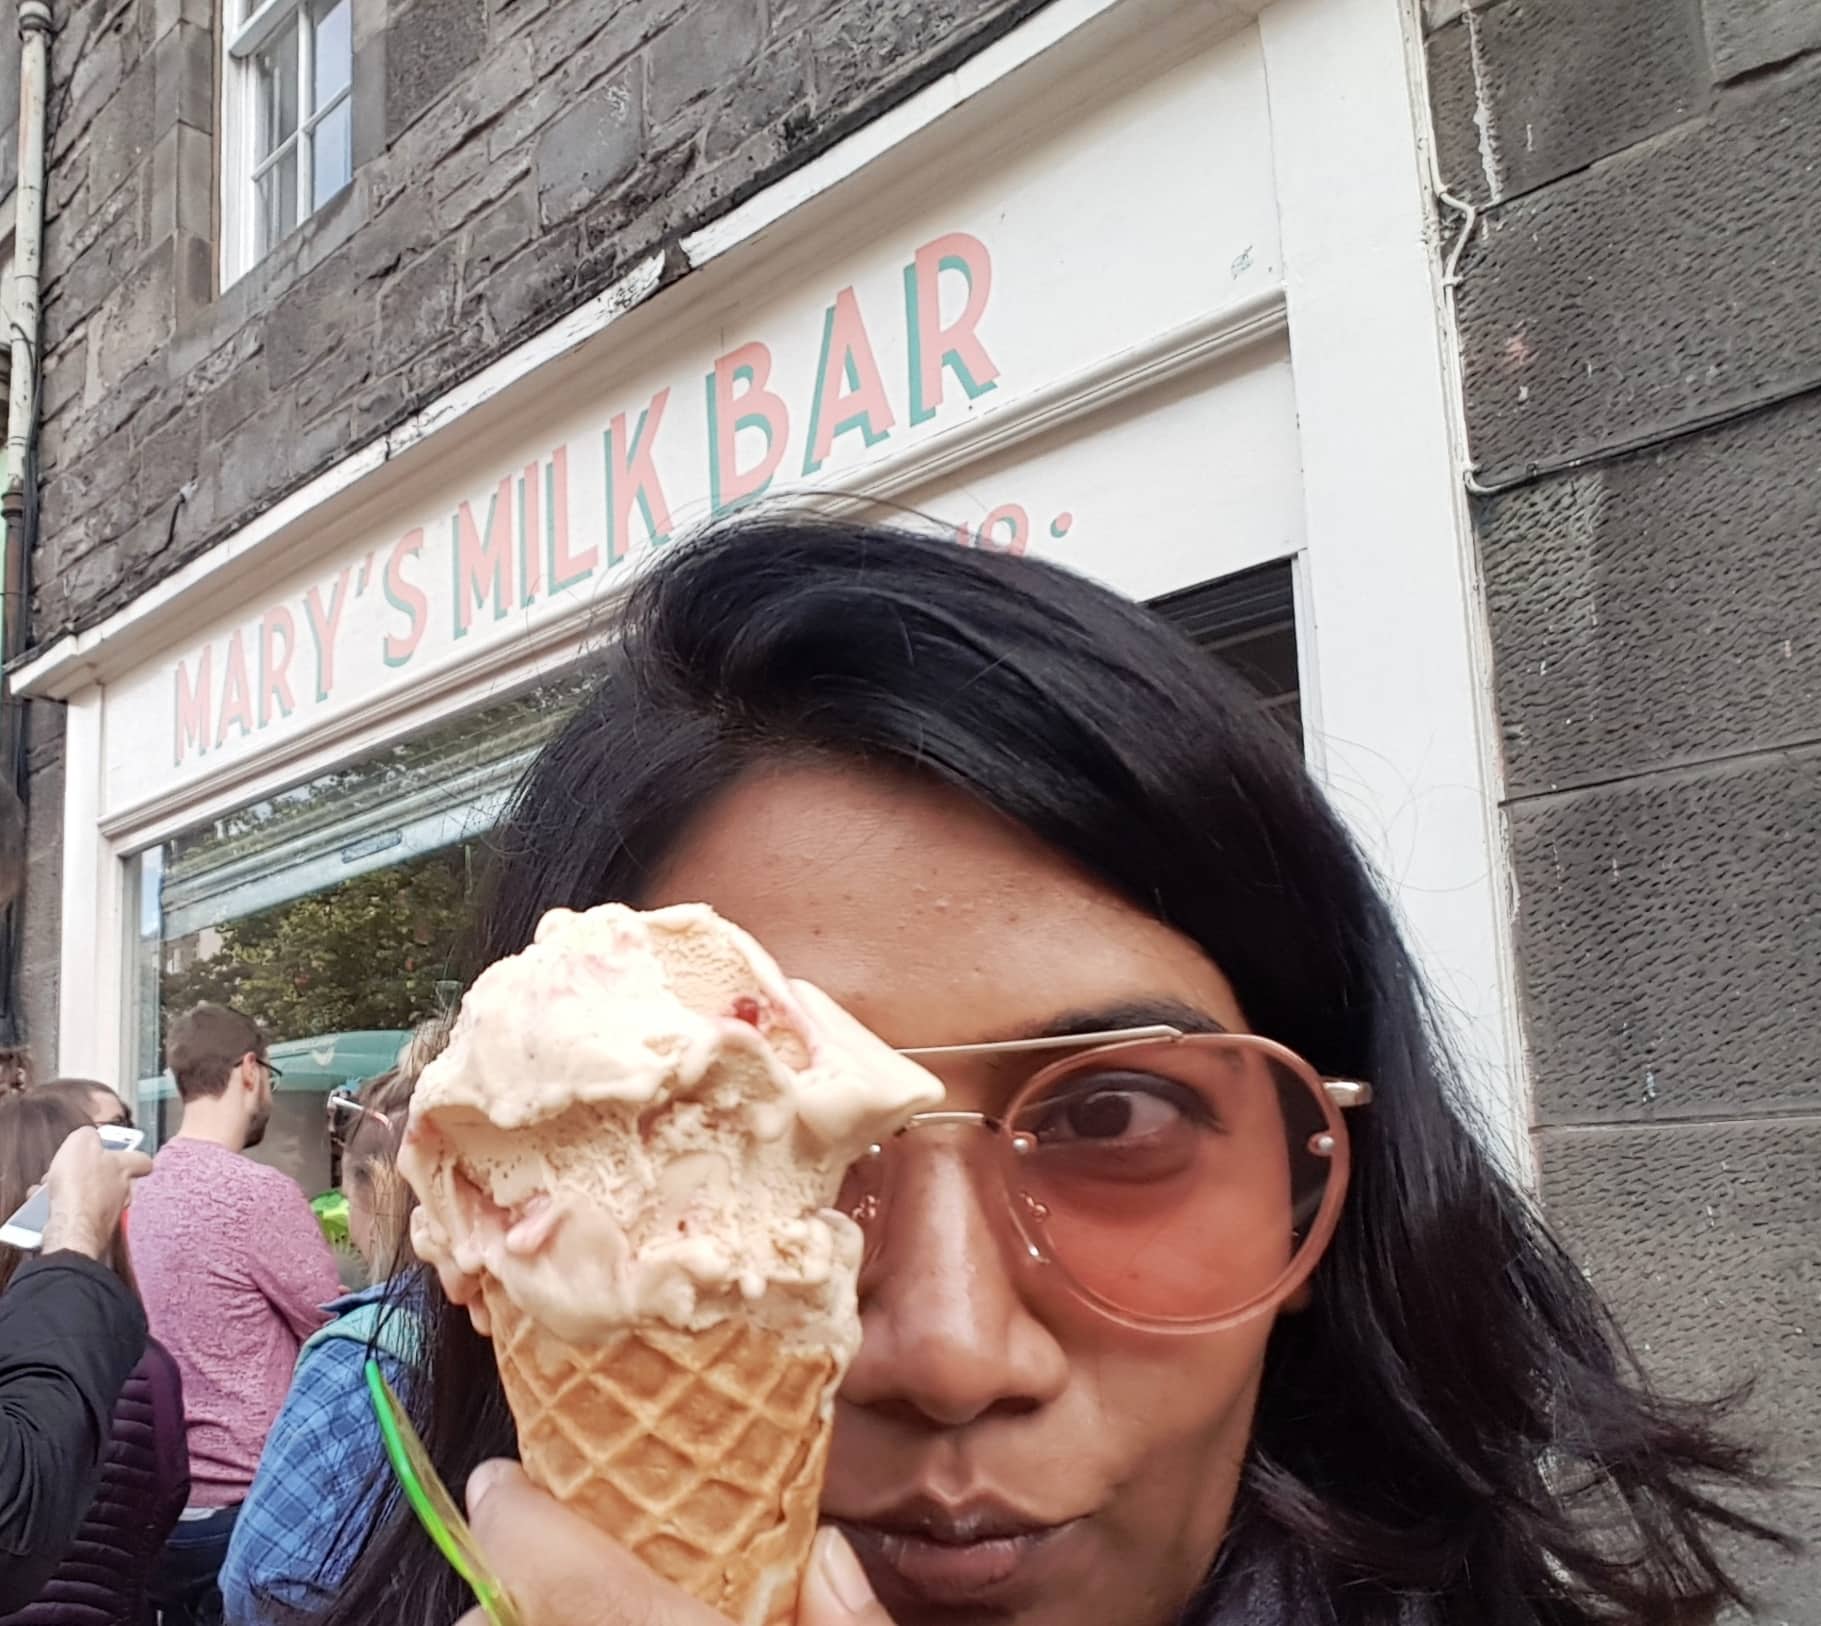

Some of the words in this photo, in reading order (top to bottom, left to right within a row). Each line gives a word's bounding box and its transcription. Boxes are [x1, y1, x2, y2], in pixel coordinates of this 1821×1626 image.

[174, 527, 428, 767] MARY'S
[452, 386, 673, 641] MILK
[706, 232, 1001, 518] BAR
